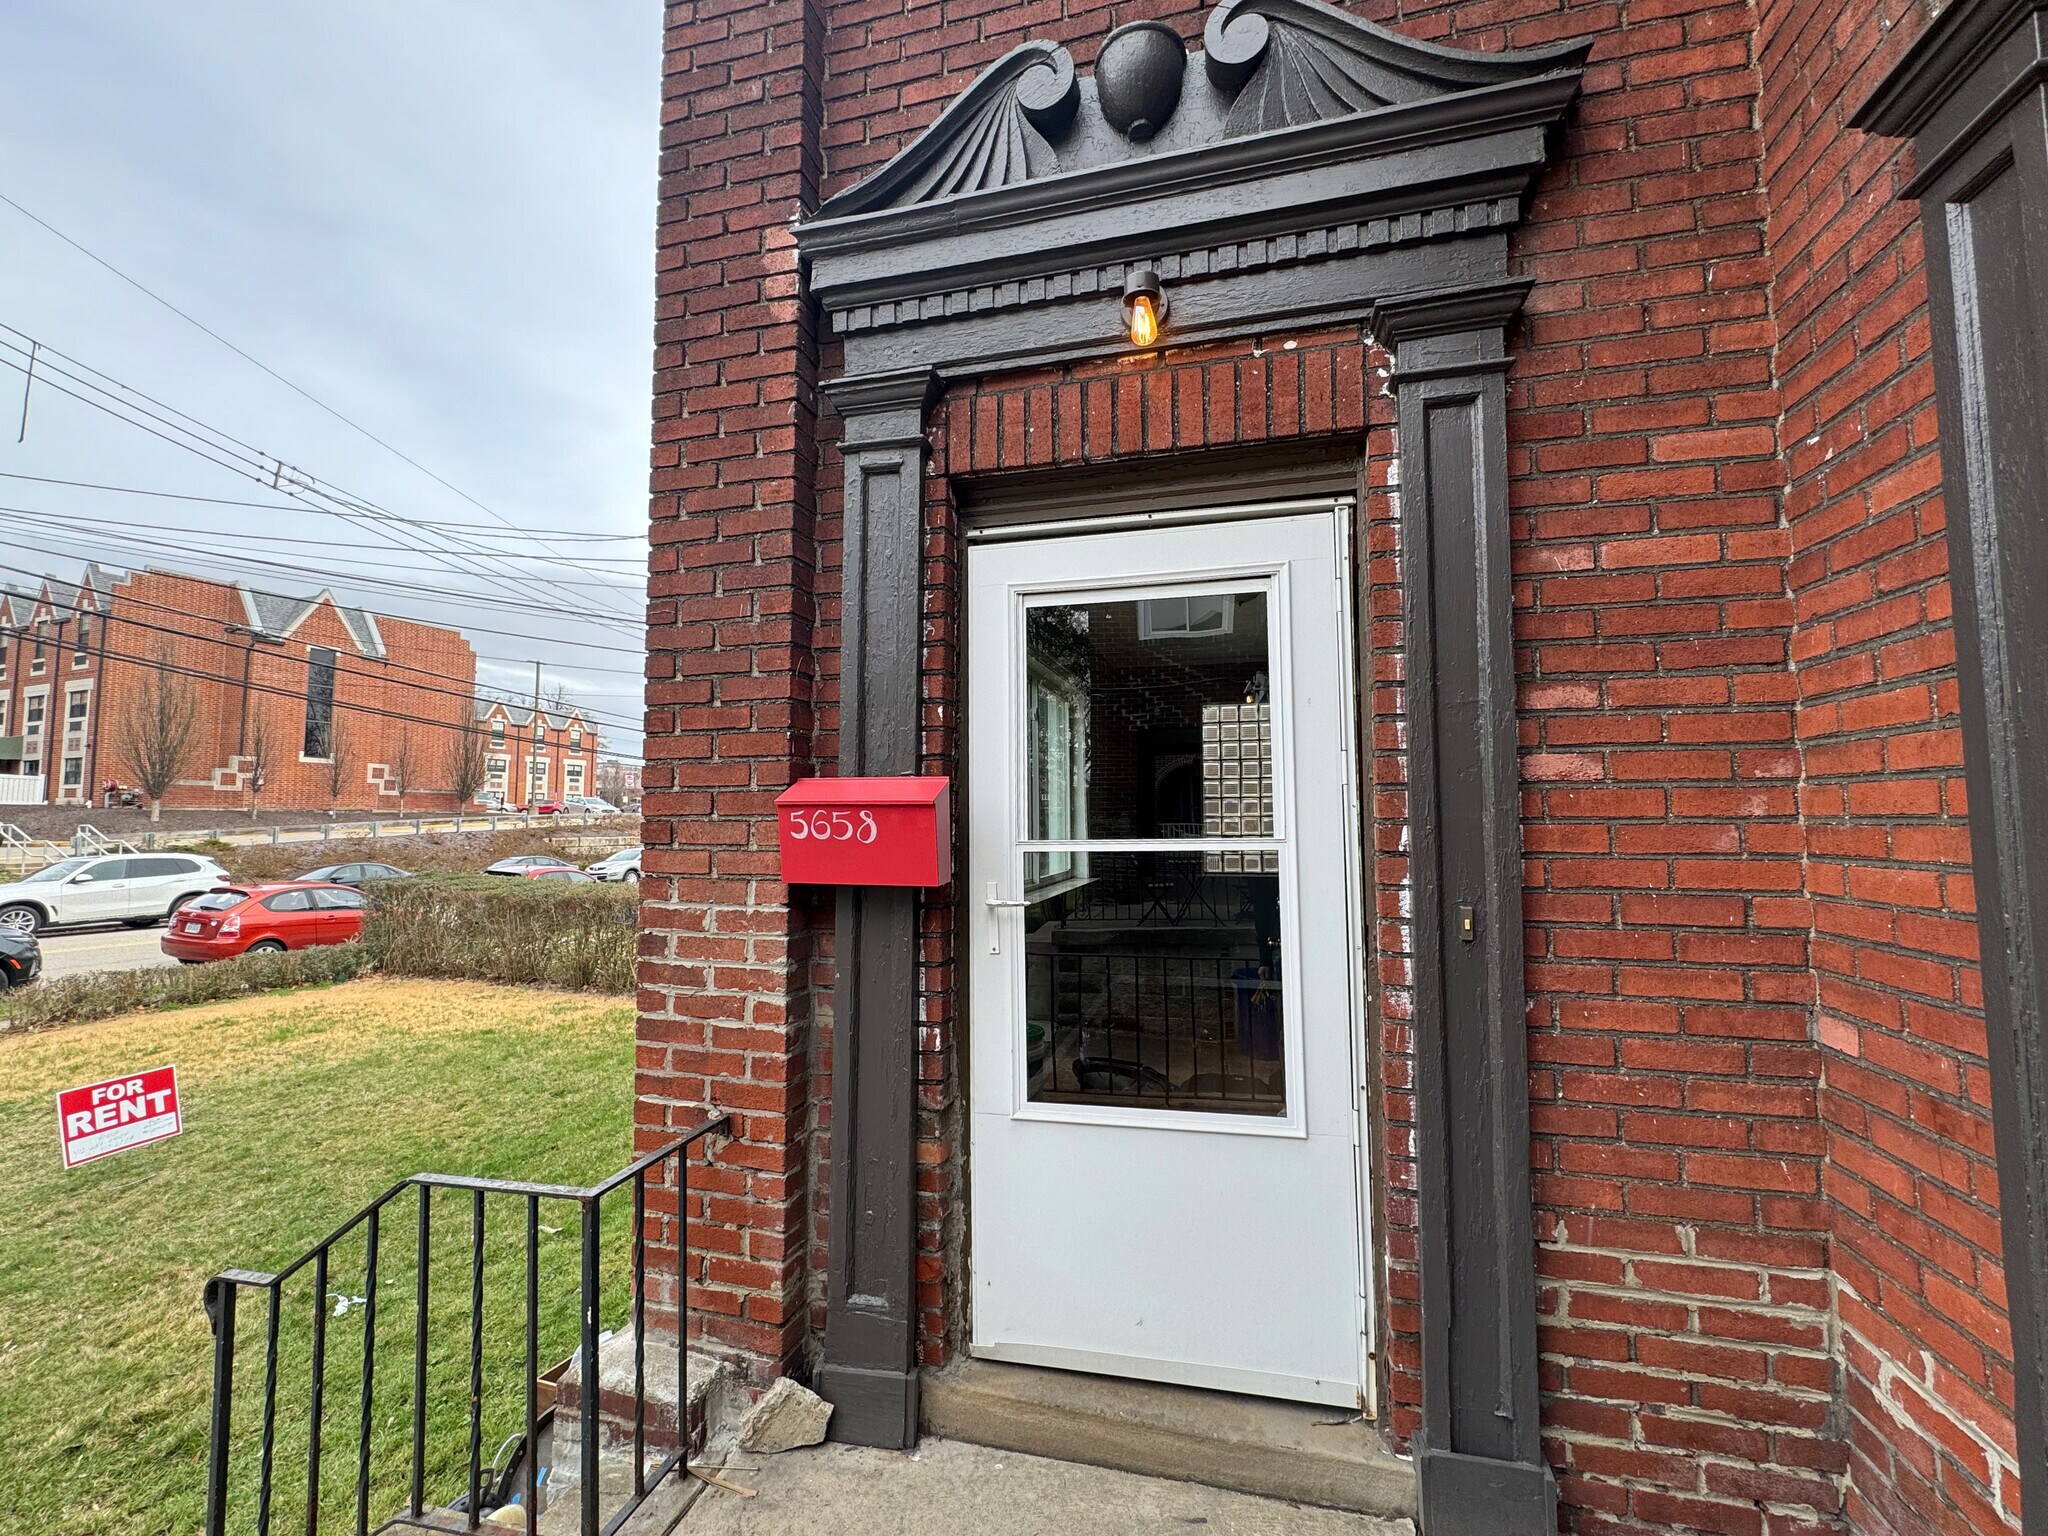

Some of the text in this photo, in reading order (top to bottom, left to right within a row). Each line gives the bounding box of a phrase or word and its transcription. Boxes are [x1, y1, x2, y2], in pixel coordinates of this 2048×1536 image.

[790, 809, 878, 844] 5658
[92, 1079, 145, 1106] FOR
[66, 1088, 172, 1139] RENT
